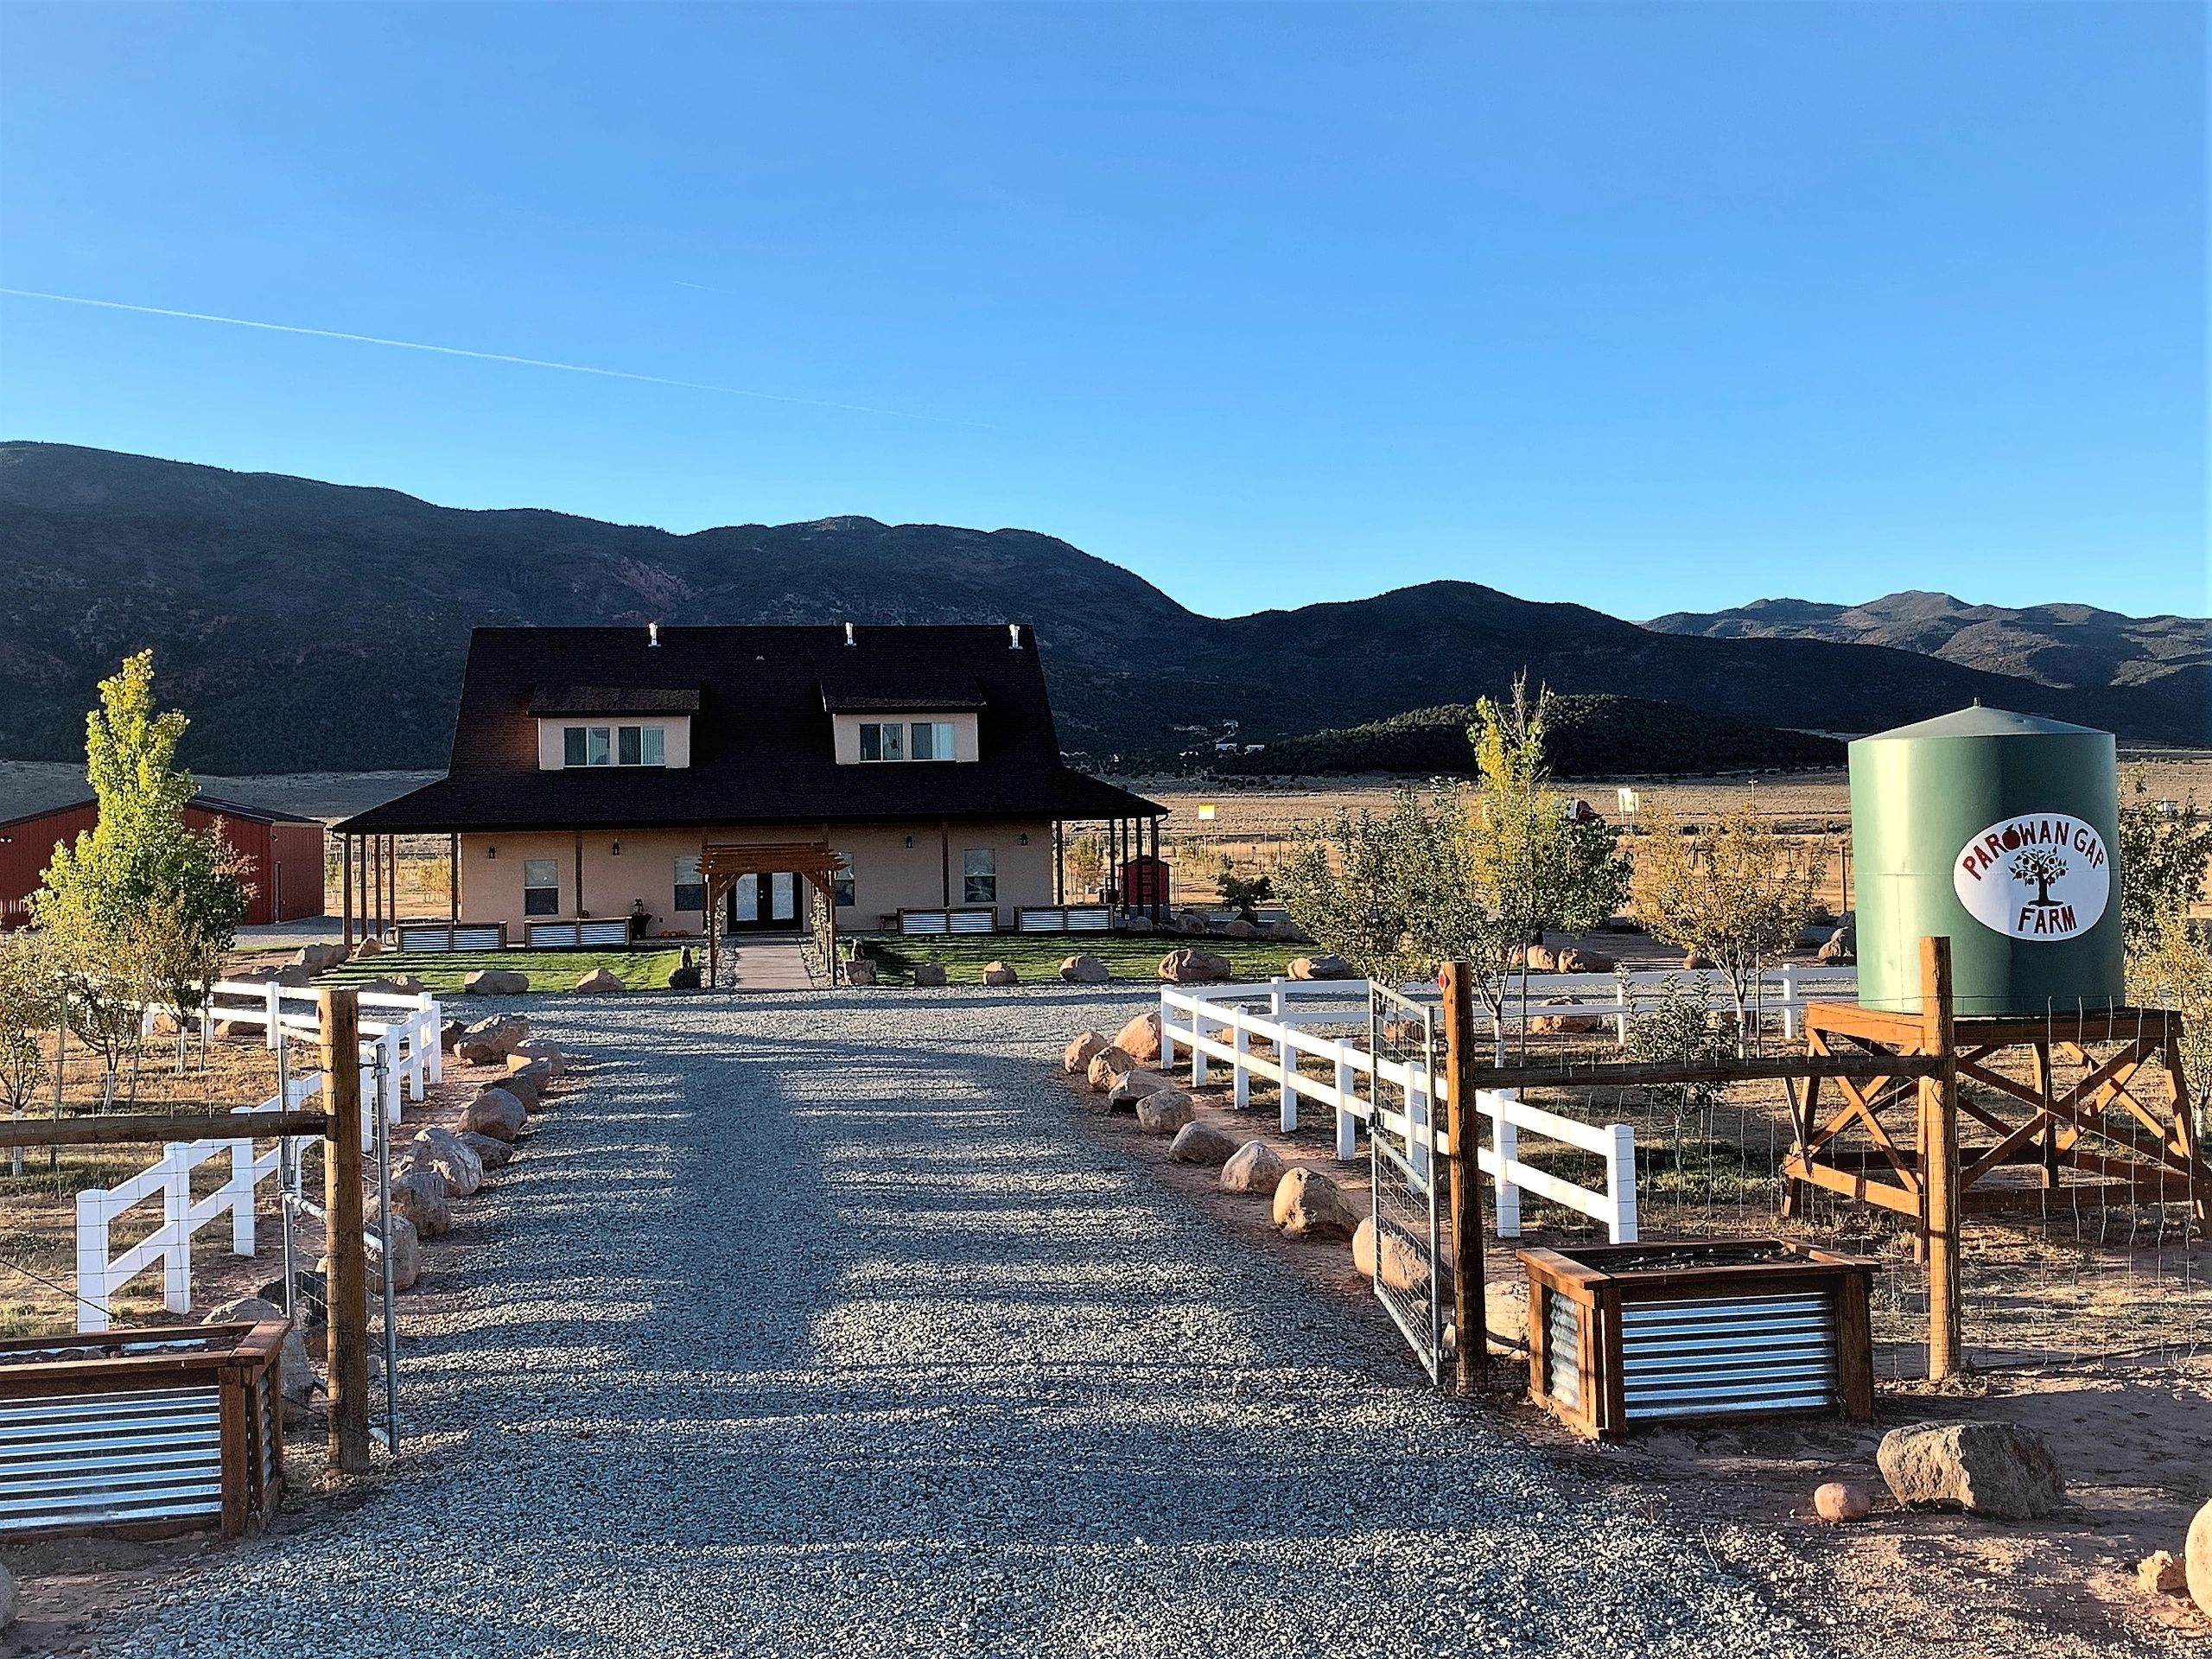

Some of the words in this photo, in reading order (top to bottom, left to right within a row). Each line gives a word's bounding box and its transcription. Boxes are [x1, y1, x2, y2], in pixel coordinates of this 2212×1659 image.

[1962, 820, 2070, 881] PAROWAN
[2074, 828, 2104, 870] GAP
[2017, 905, 2078, 934] FARM
